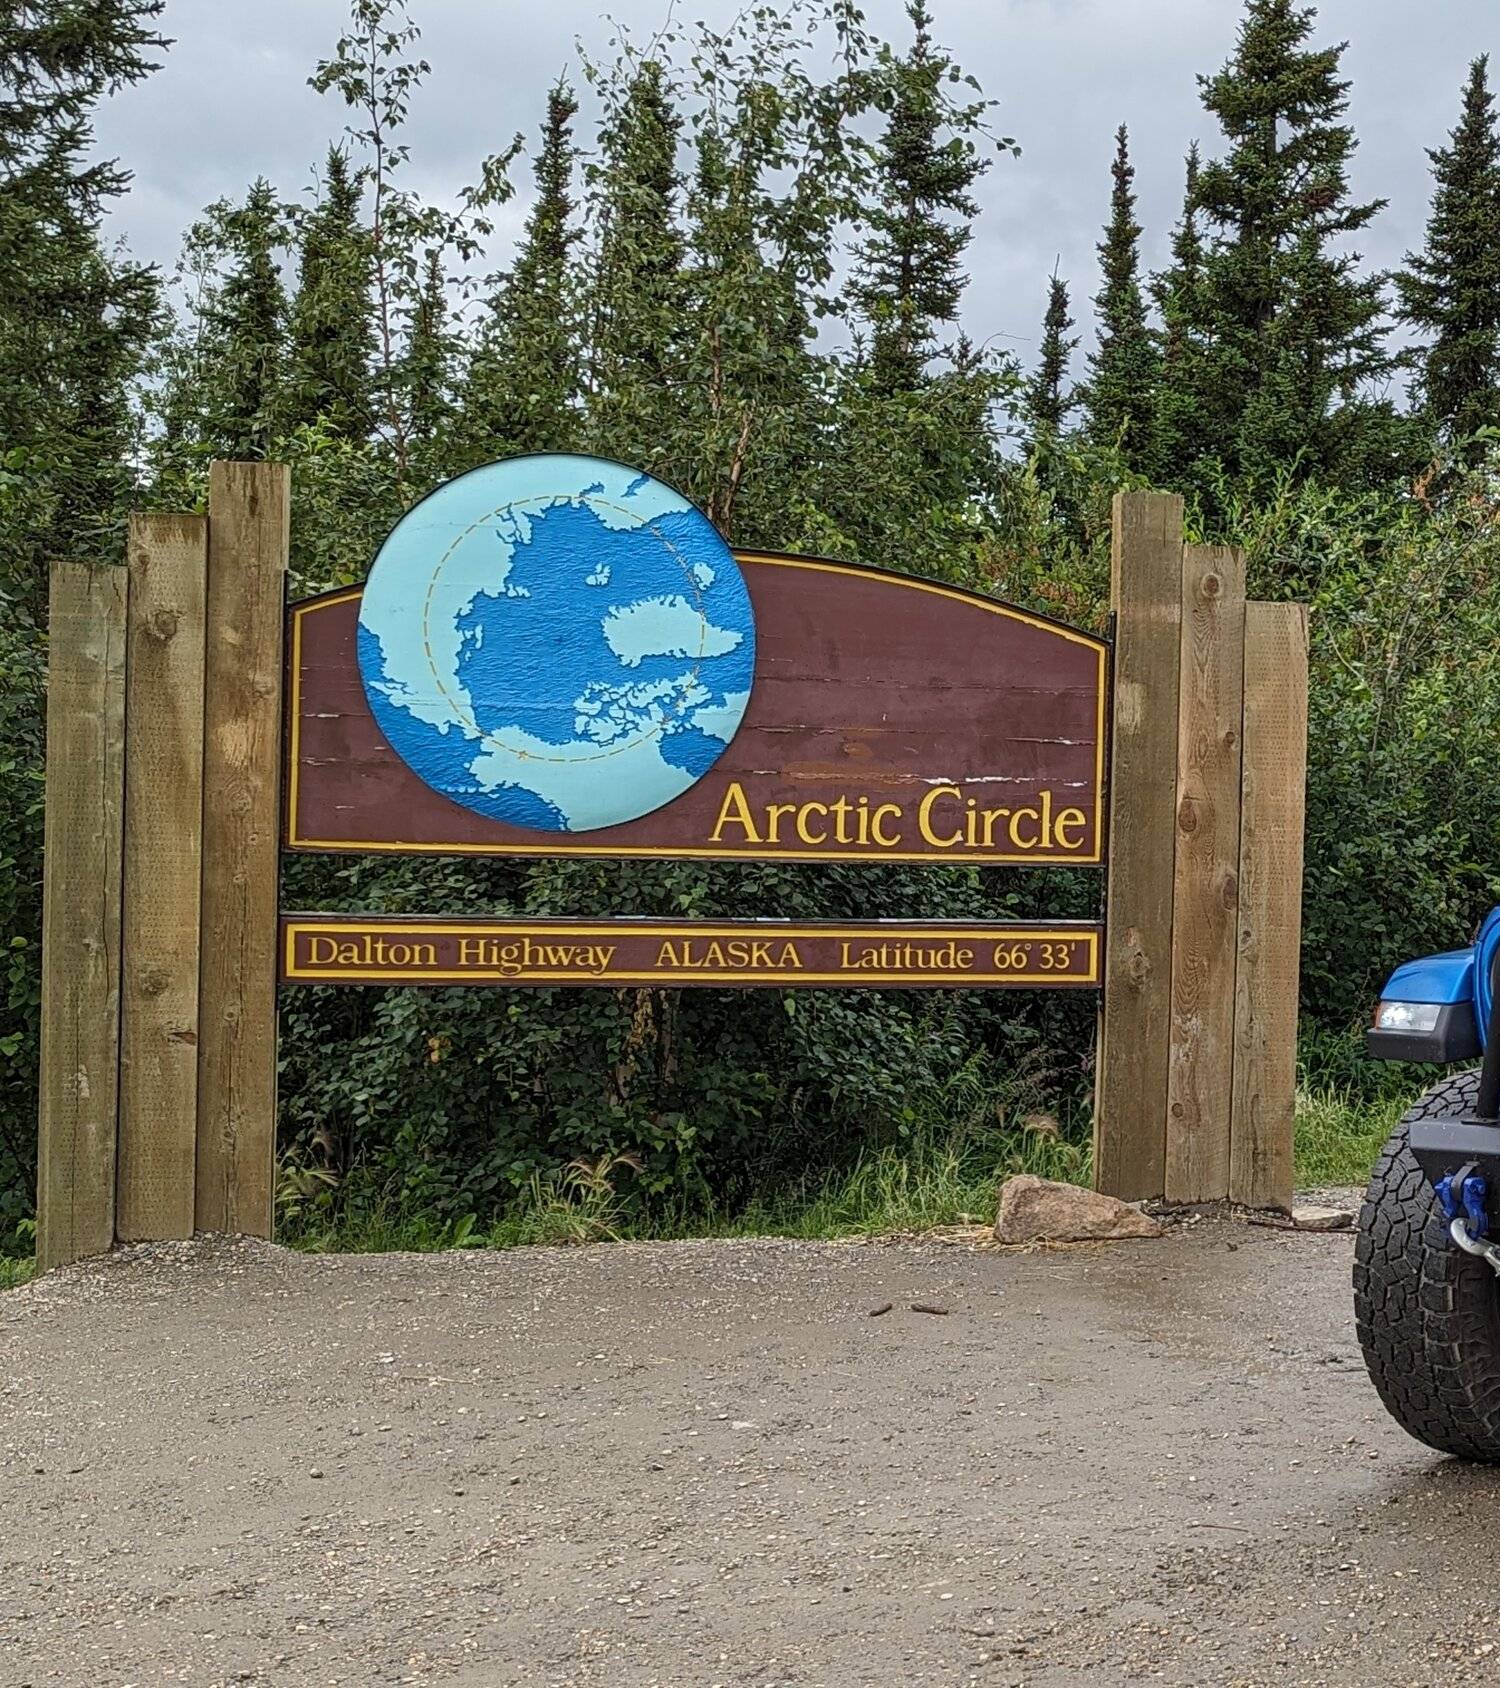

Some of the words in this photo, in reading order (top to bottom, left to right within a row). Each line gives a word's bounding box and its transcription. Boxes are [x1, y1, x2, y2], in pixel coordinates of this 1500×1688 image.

[708, 782, 901, 845] Arctic
[919, 786, 1087, 848] Circle
[307, 936, 438, 965] Dalton
[458, 937, 616, 975] Highway
[654, 941, 803, 968] ALASKA
[840, 942, 973, 968] Latitude
